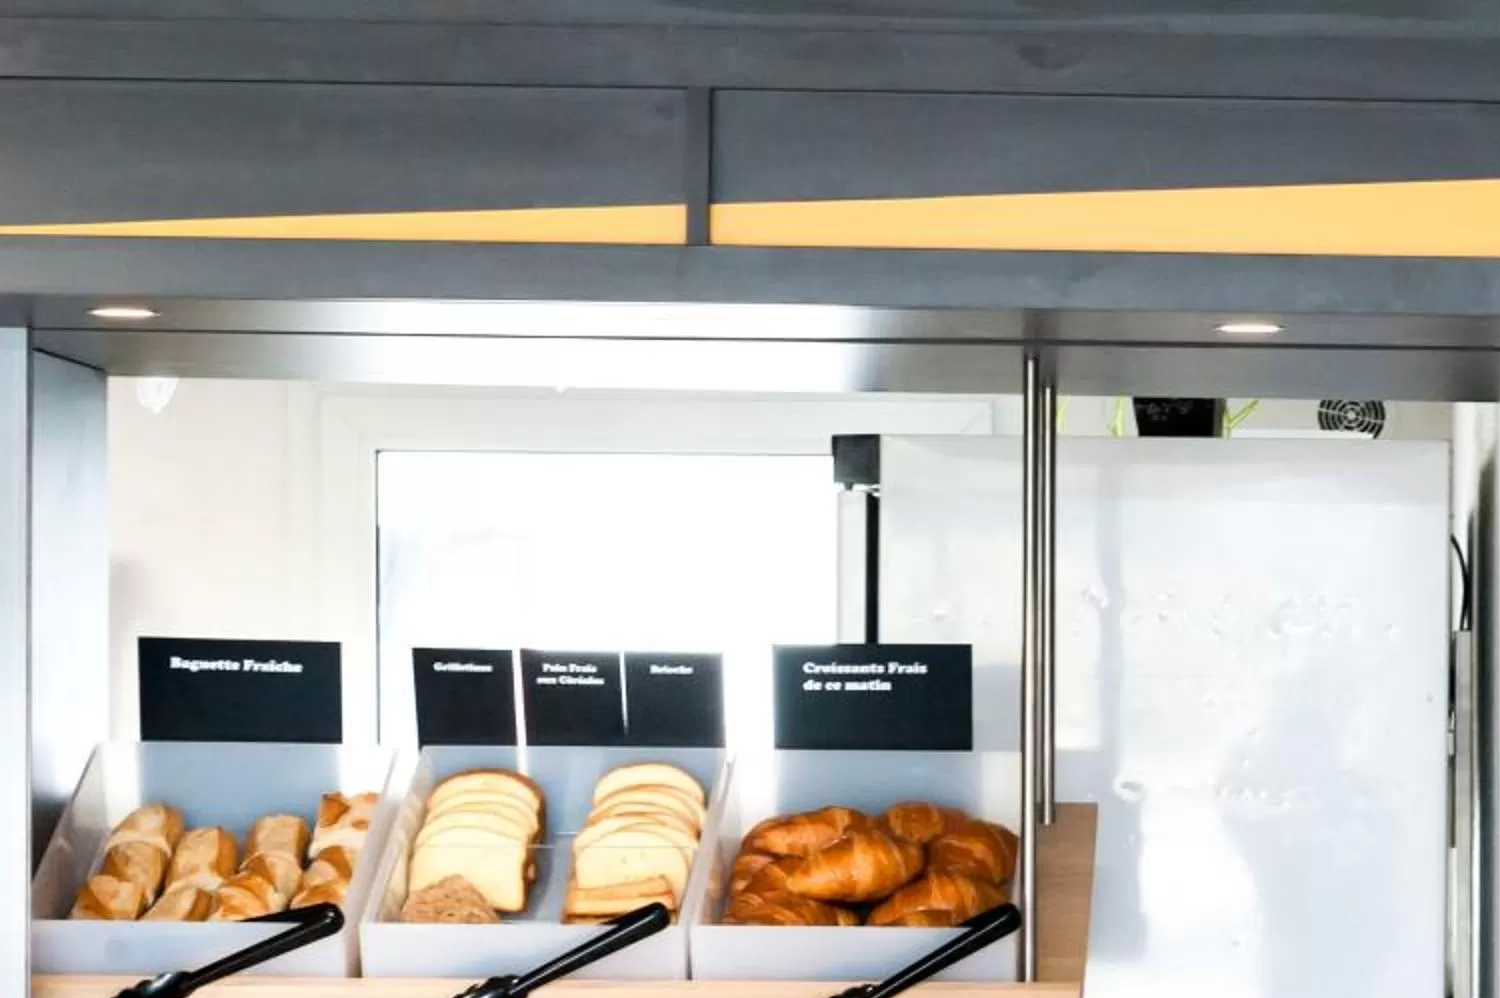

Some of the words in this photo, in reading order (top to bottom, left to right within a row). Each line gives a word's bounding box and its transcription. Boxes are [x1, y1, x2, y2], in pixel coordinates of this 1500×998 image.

[169, 656, 240, 673] Baguette
[542, 662, 567, 673] Pain
[570, 663, 598, 674] Frais
[649, 664, 694, 675] Brioche
[802, 661, 884, 675] Croissants
[888, 661, 928, 675] Frais
[802, 678, 822, 692] de
[825, 681, 842, 692] ce
[845, 679, 892, 692] matin
